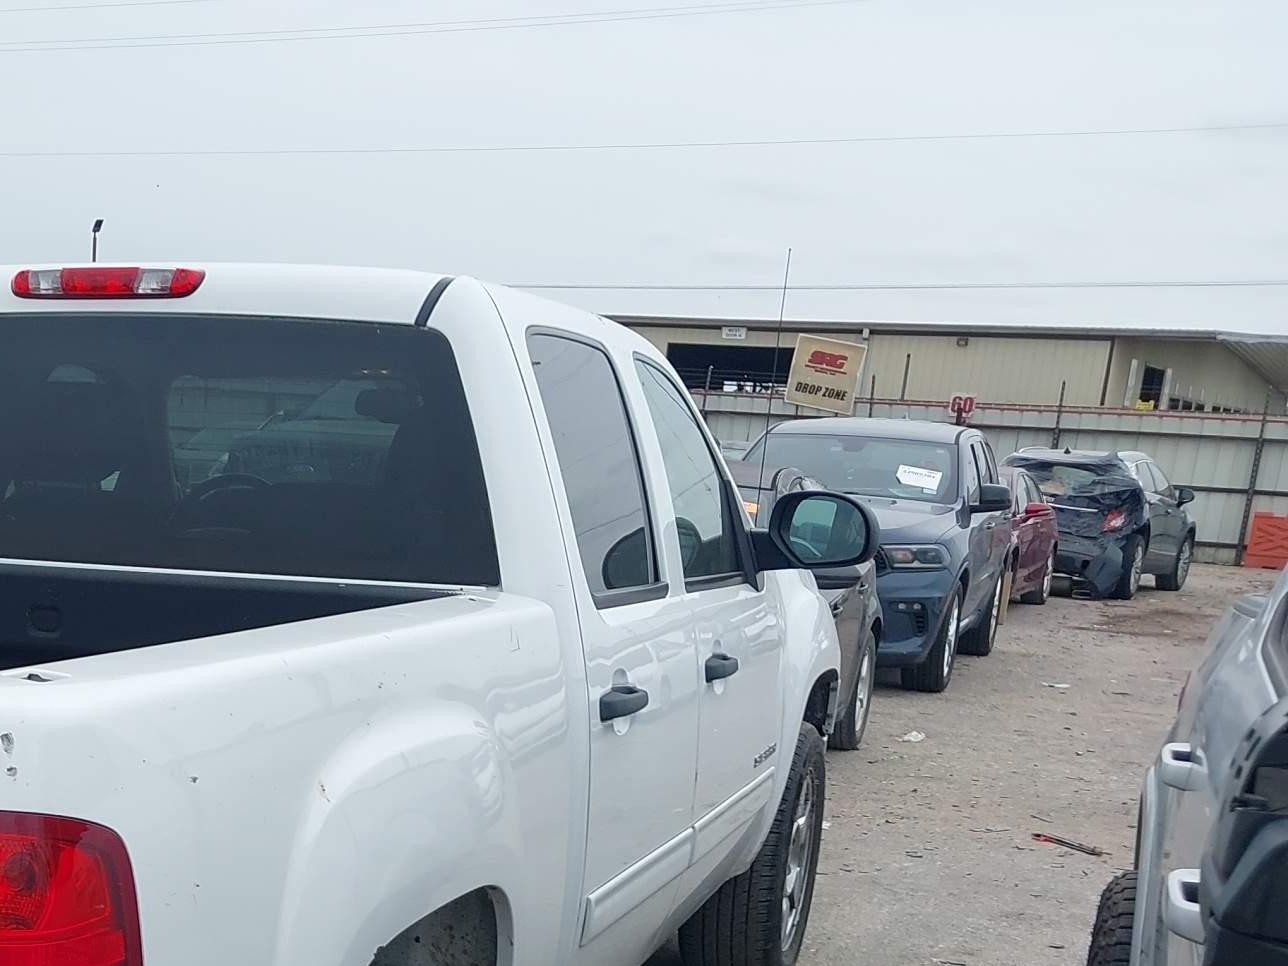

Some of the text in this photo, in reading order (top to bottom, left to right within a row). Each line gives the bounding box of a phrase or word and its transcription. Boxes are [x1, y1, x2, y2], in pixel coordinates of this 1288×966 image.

[795, 382, 848, 401] DROP ZONE
[951, 395, 975, 413] 60
